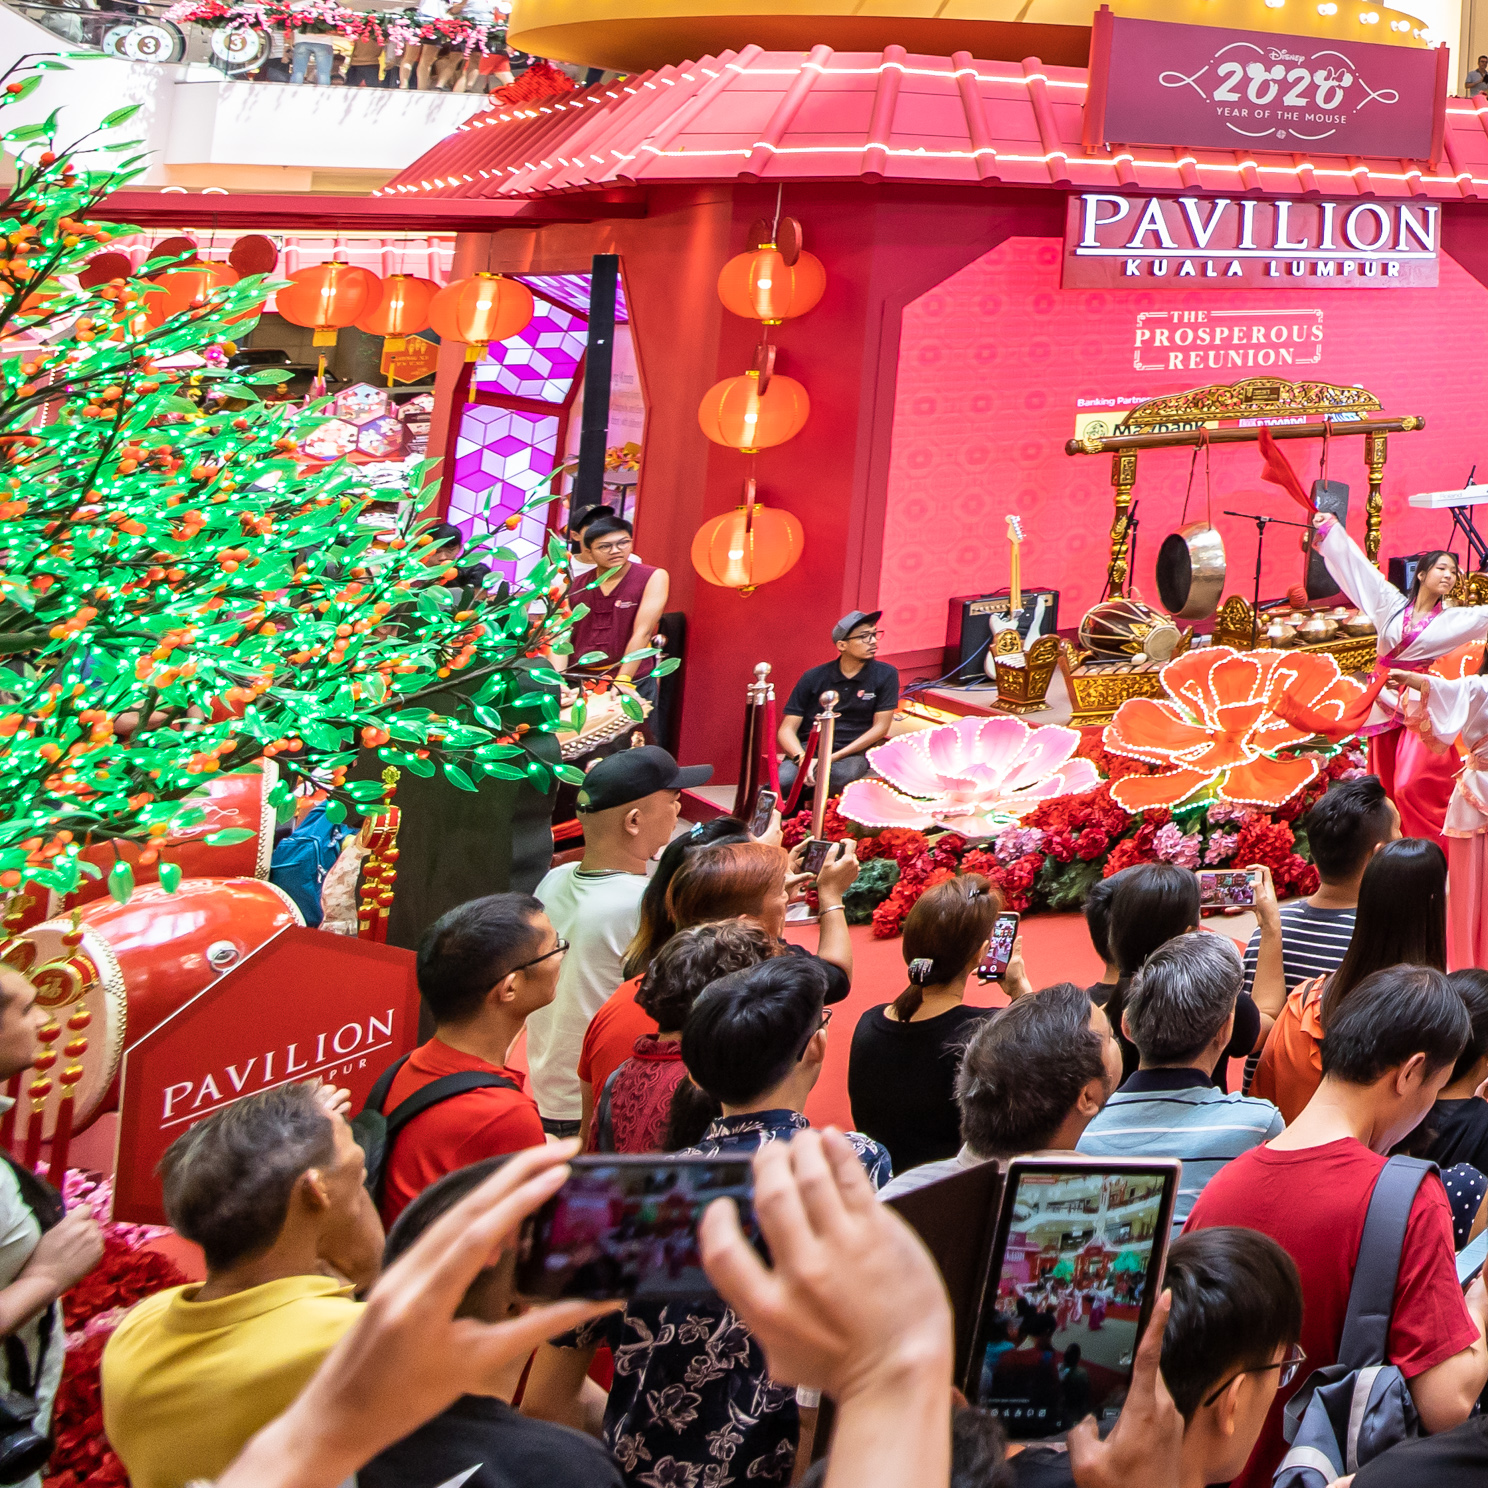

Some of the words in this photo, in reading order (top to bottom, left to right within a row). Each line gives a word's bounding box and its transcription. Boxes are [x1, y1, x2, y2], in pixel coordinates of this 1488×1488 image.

[143, 37, 156, 52] 3
[229, 35, 241, 50] 3
[1267, 47, 1306, 66] Disney
[1213, 62, 1353, 110] 2020
[1216, 107, 1248, 118] YEAR
[1254, 110, 1271, 119] OF
[1276, 111, 1299, 121] THE
[1305, 113, 1347, 124] MOUSE
[1080, 194, 1438, 252] PAVILION
[1125, 259, 1243, 277] KUALA
[1270, 260, 1401, 277] LUMPUR
[1170, 311, 1208, 323] THE
[1134, 324, 1324, 347] PROSPEROUS
[1168, 348, 1294, 370] REUNION
[1077, 397, 1114, 407] Banking
[162, 1008, 395, 1120] PAVILION
[328, 1058, 367, 1081] PUR
